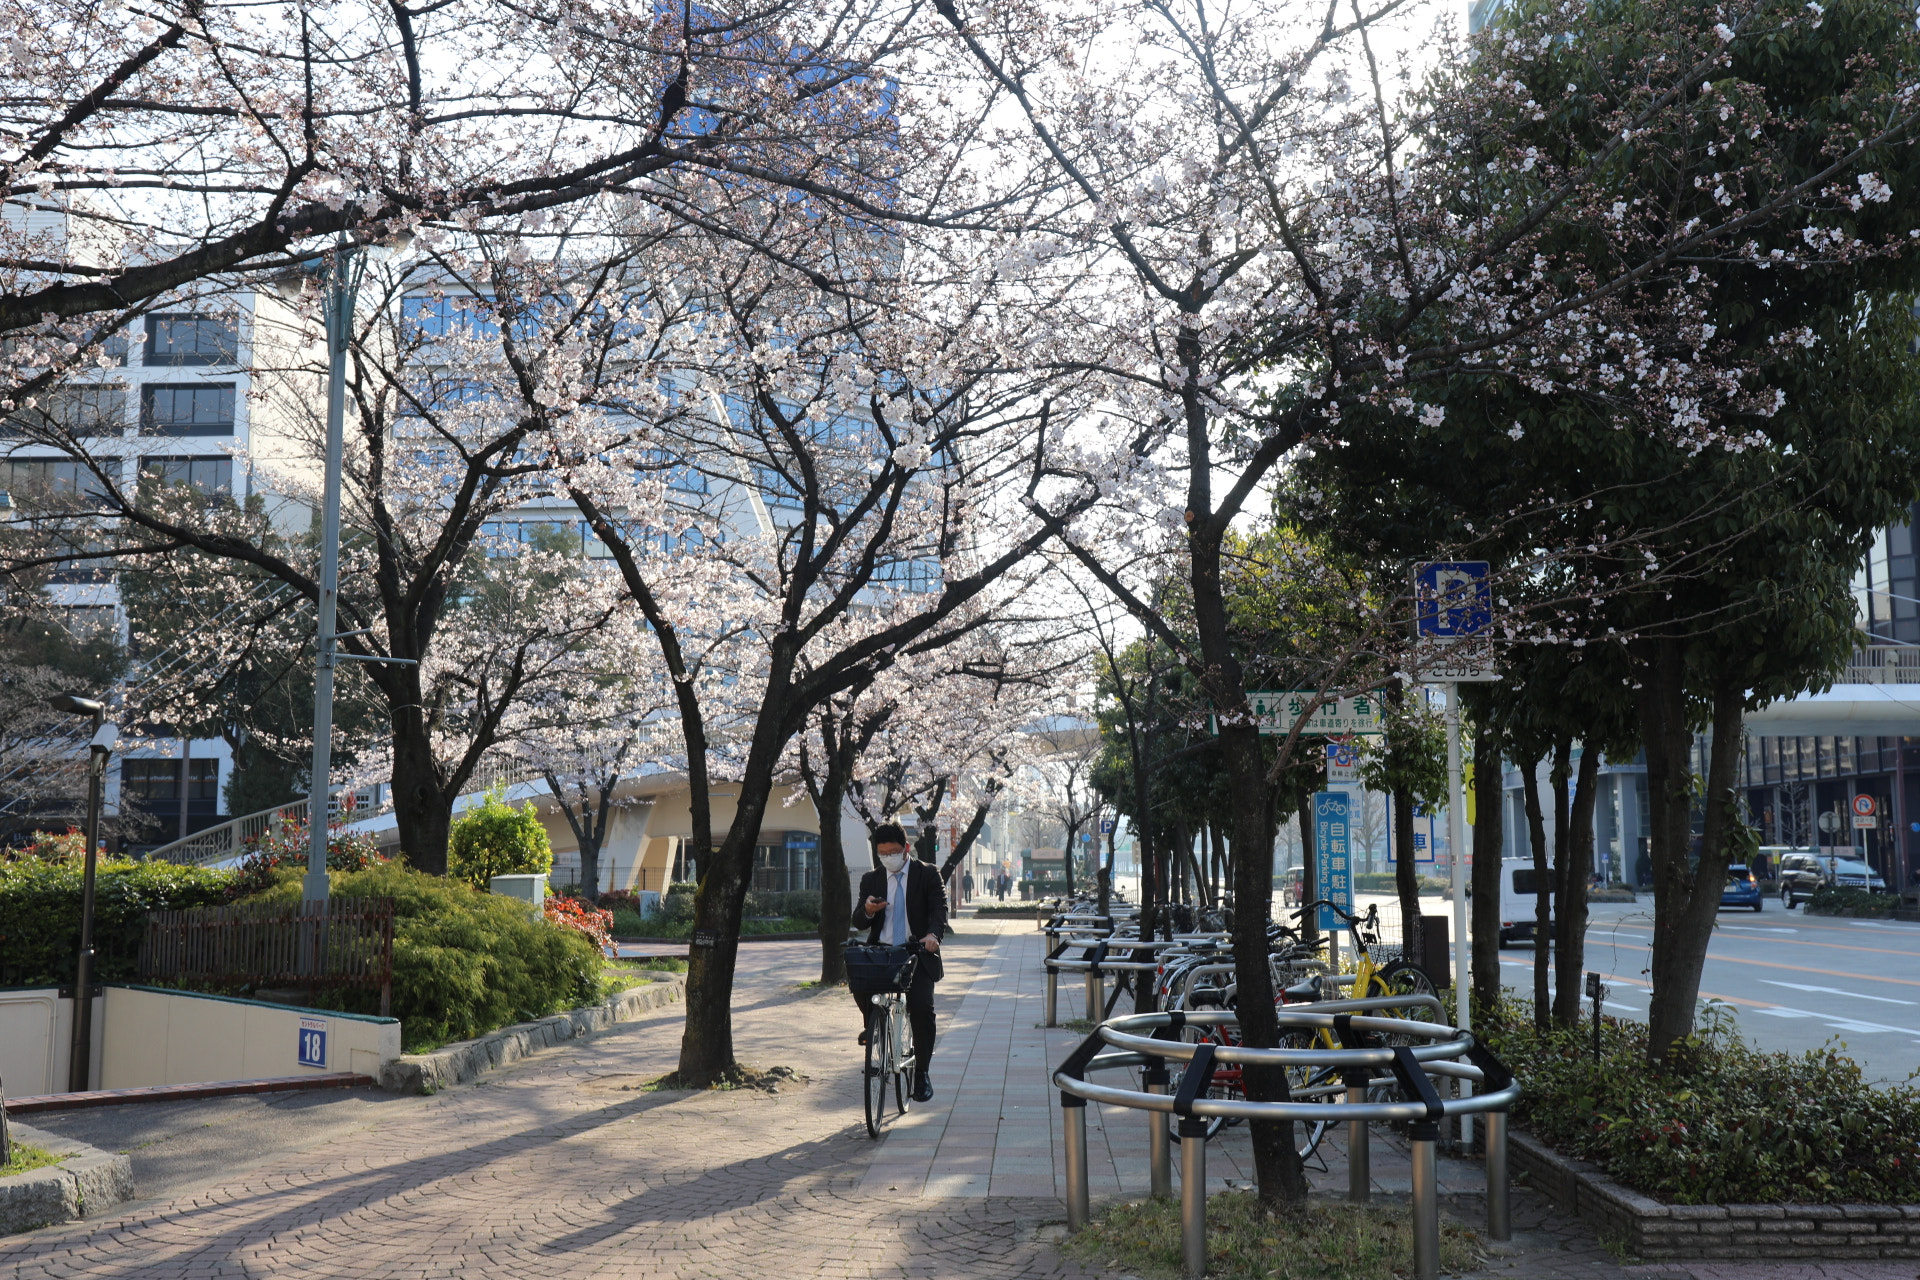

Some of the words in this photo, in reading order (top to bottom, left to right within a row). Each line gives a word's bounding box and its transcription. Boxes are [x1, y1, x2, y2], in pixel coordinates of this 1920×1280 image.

[1436, 570, 1477, 629] P
[1432, 664, 1480, 677] ここから
[1288, 696, 1371, 716] 歩行者
[1288, 718, 1373, 729] 自車は車道寄りを徐行
[1103, 821, 1112, 833] P
[1319, 821, 1330, 884] Bicycle-Parking
[1331, 822, 1348, 925] 自転車駐輪場
[1321, 886, 1330, 912] Spe
[304, 1032, 321, 1062] 18
